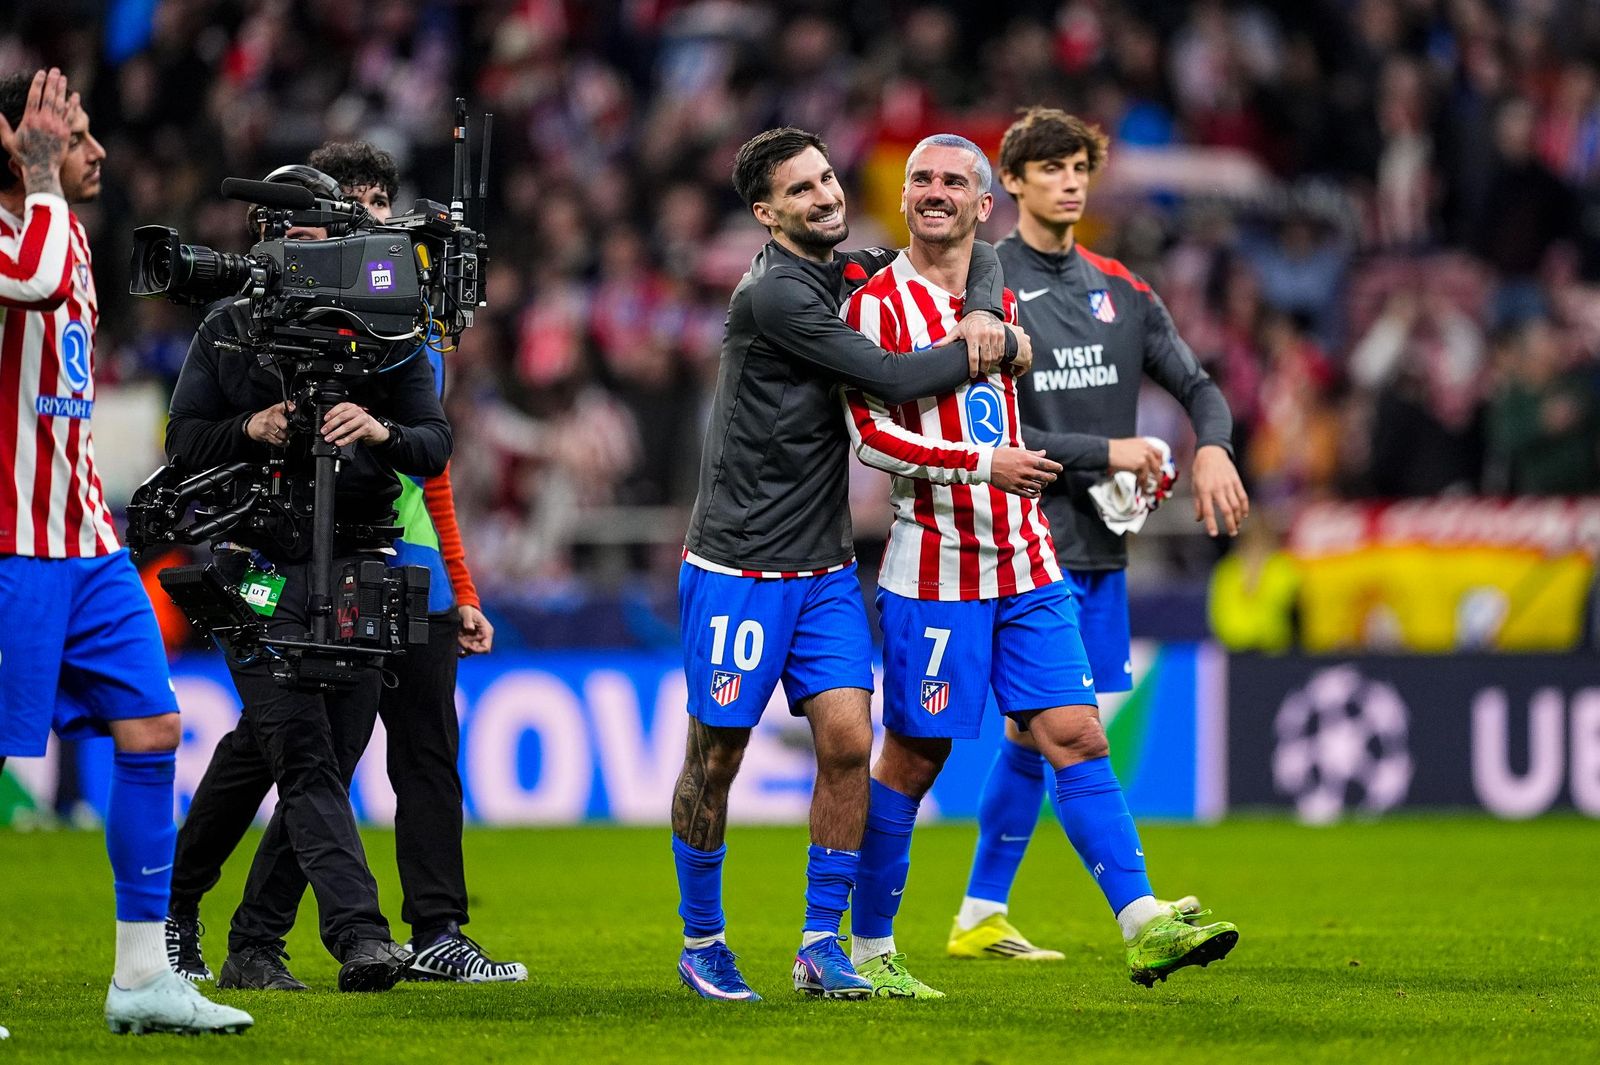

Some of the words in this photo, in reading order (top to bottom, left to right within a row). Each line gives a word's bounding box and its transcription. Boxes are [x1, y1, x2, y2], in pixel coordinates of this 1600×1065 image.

[374, 275, 389, 285] pm
[1052, 344, 1104, 369] VISIT
[1033, 363, 1119, 392] RWANDA
[39, 397, 86, 417] RIYADH
[710, 615, 764, 671] 10
[923, 626, 951, 677] 7
